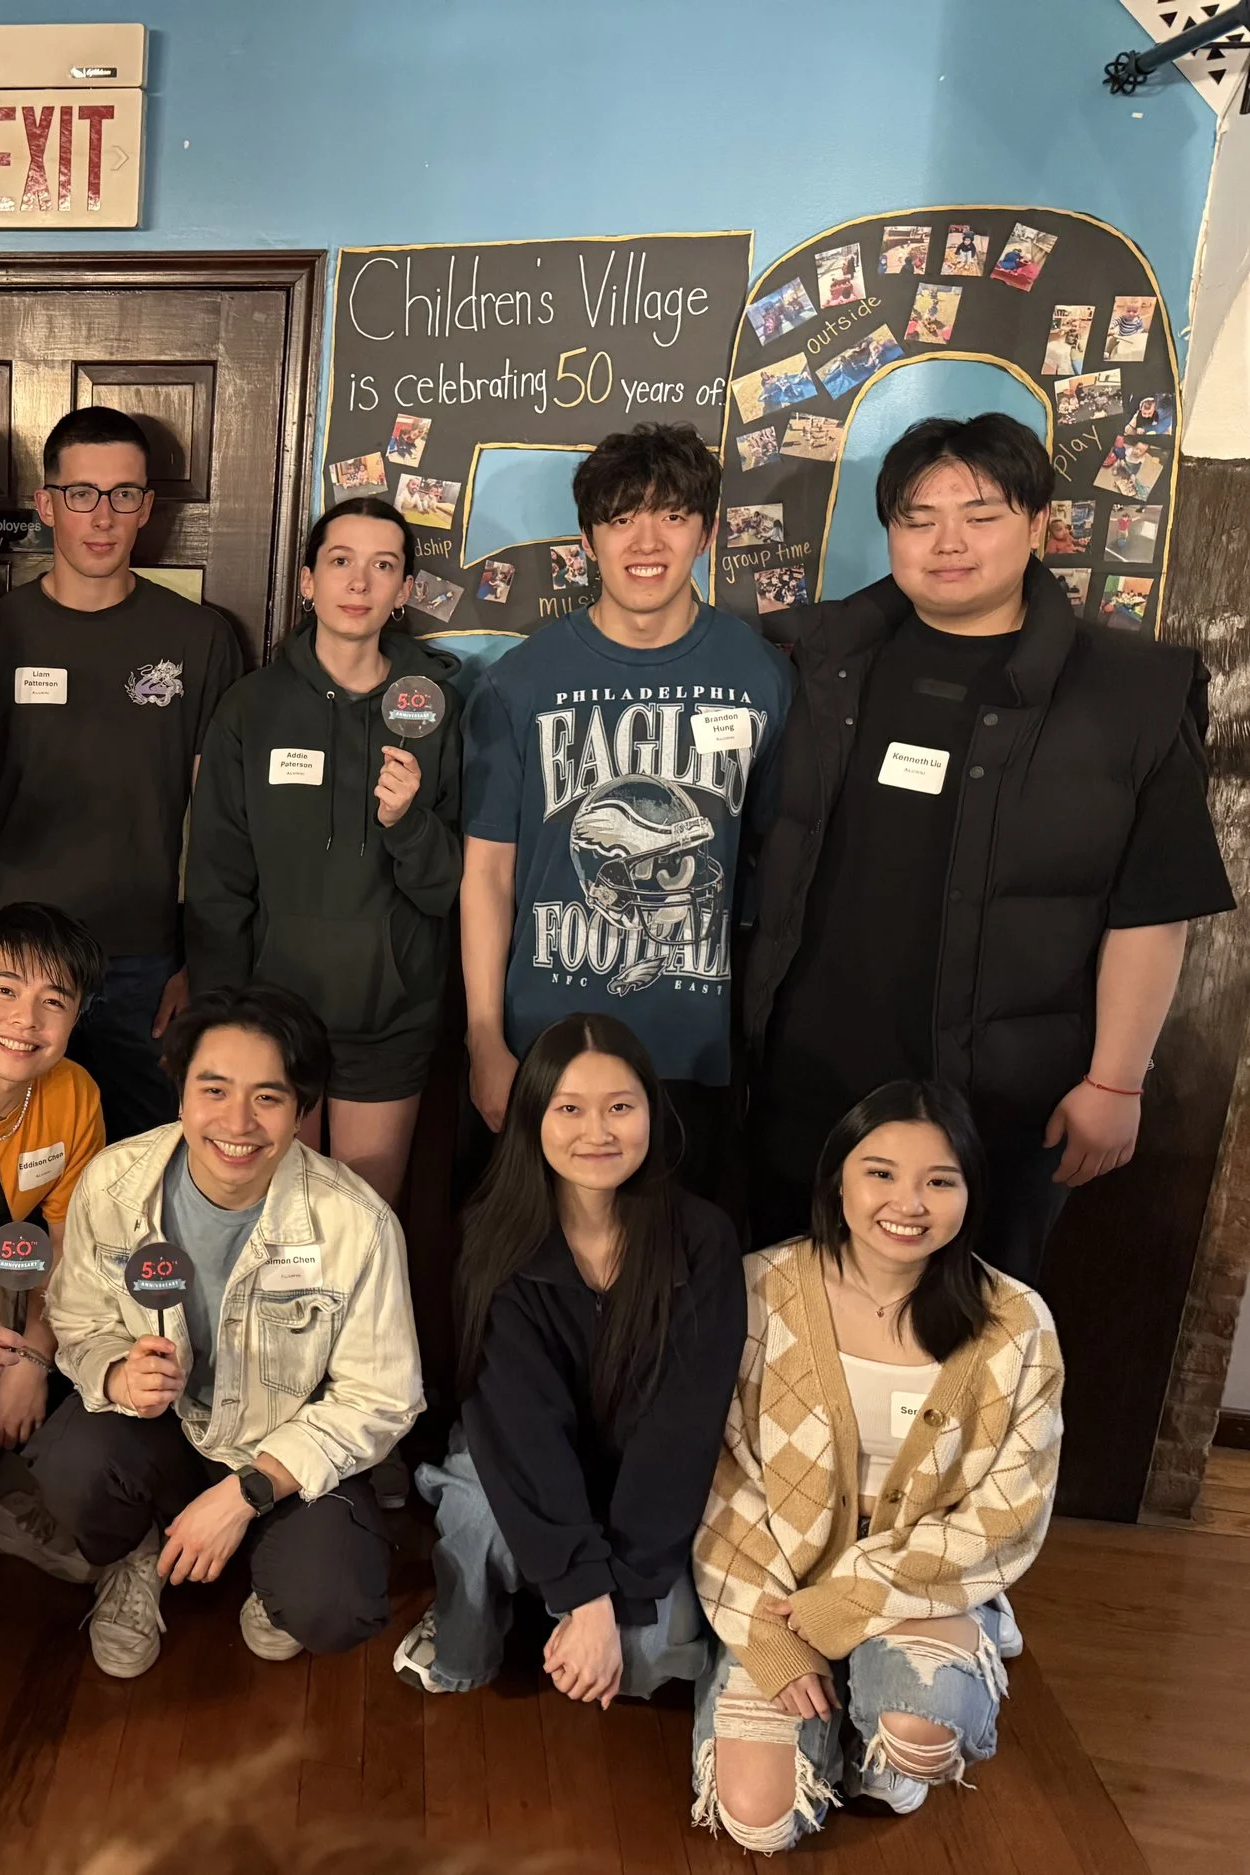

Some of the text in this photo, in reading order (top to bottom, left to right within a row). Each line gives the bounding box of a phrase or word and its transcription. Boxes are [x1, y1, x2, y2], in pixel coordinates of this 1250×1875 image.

[349, 249, 710, 348] Children's Village
[806, 294, 883, 355] outside
[349, 372, 379, 412] is
[394, 358, 547, 414] celebrating
[553, 346, 613, 408] 50
[619, 377, 685, 414] years
[1053, 424, 1103, 482] play
[721, 540, 813, 584] group time
[23, 679, 59, 687] Patterson
[556, 685, 752, 704] PHILADELPHIA
[704, 713, 739, 724] Brandon
[712, 724, 735, 733] Hung
[286, 752, 308, 760] Addie
[535, 701, 768, 824] EAGLES
[892, 751, 943, 769] Kenneth Liu
[280, 761, 313, 769] Paterson
[551, 973, 588, 988] NFC
[18, 1158, 47, 1171] Eddison
[292, 1256, 316, 1264] Chen
